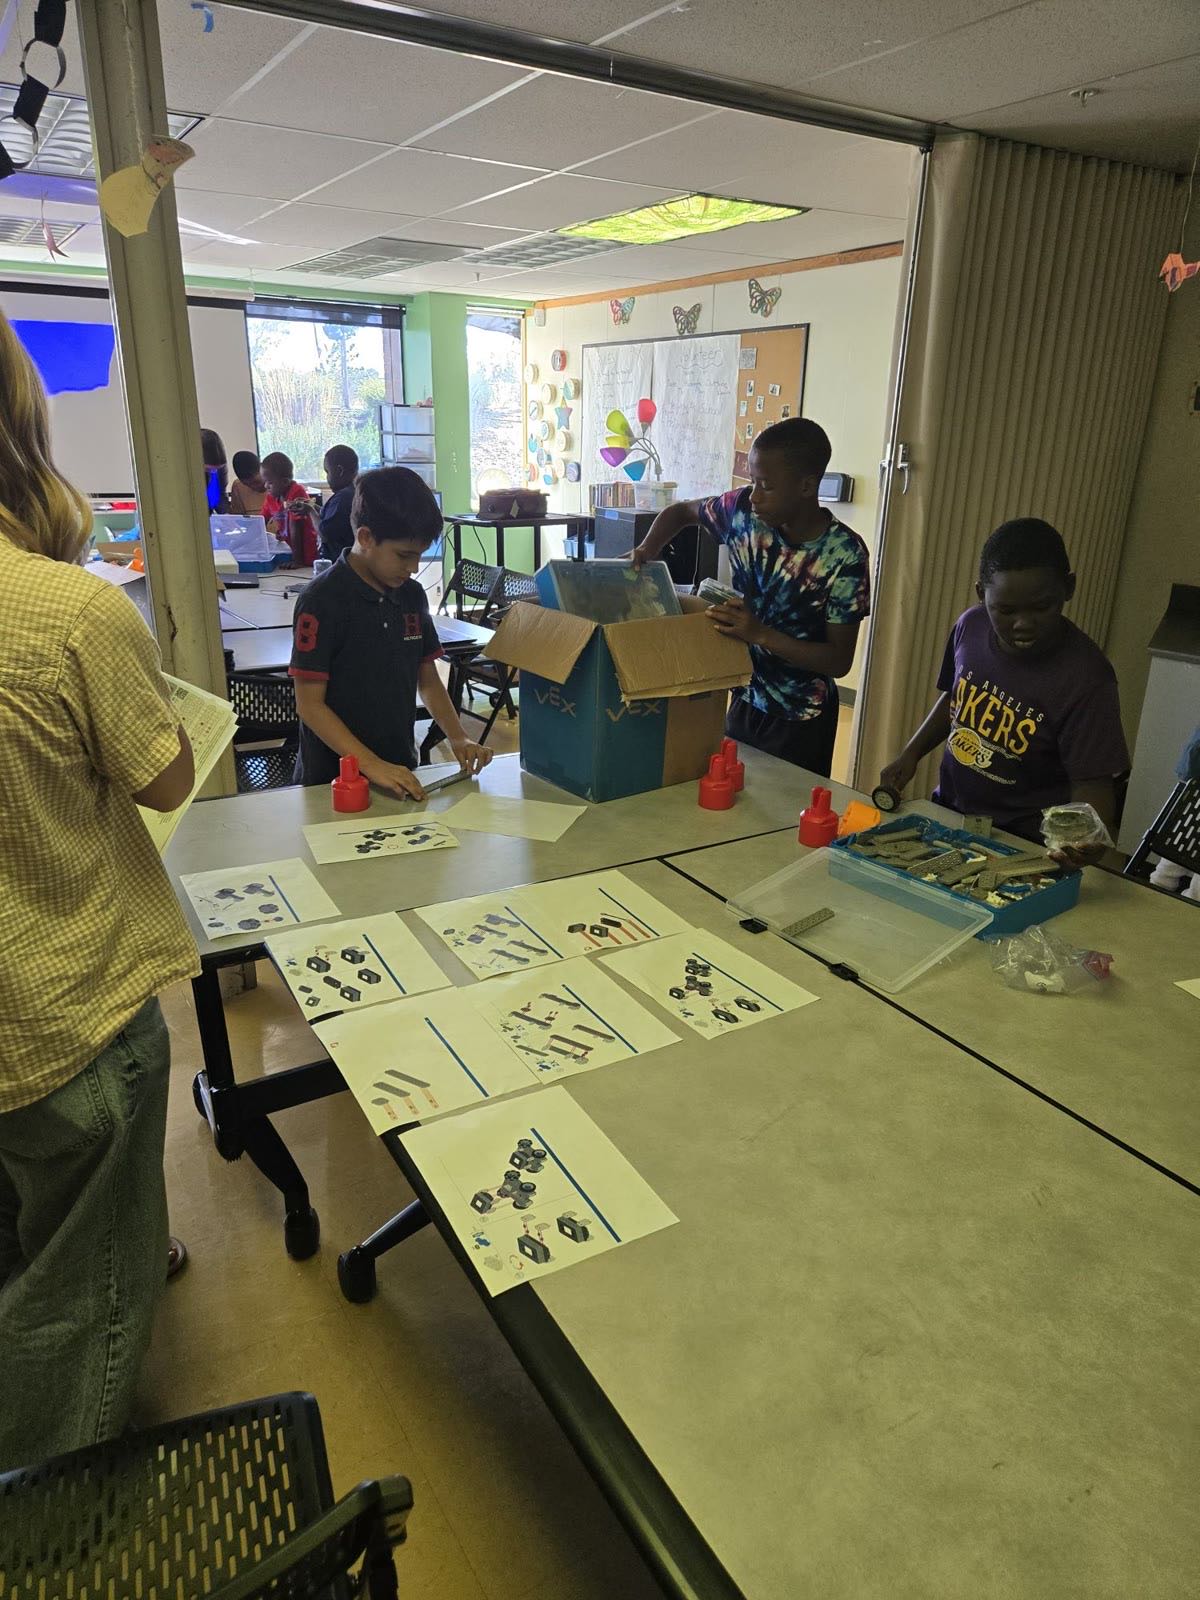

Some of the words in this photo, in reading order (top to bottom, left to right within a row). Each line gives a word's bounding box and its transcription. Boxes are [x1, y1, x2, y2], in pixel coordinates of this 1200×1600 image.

[296, 613, 319, 652] 8
[534, 687, 576, 717] VEX
[606, 701, 662, 722] VEX
[951, 677, 1037, 755] AKERS
[982, 680, 1044, 722] ANGELES
